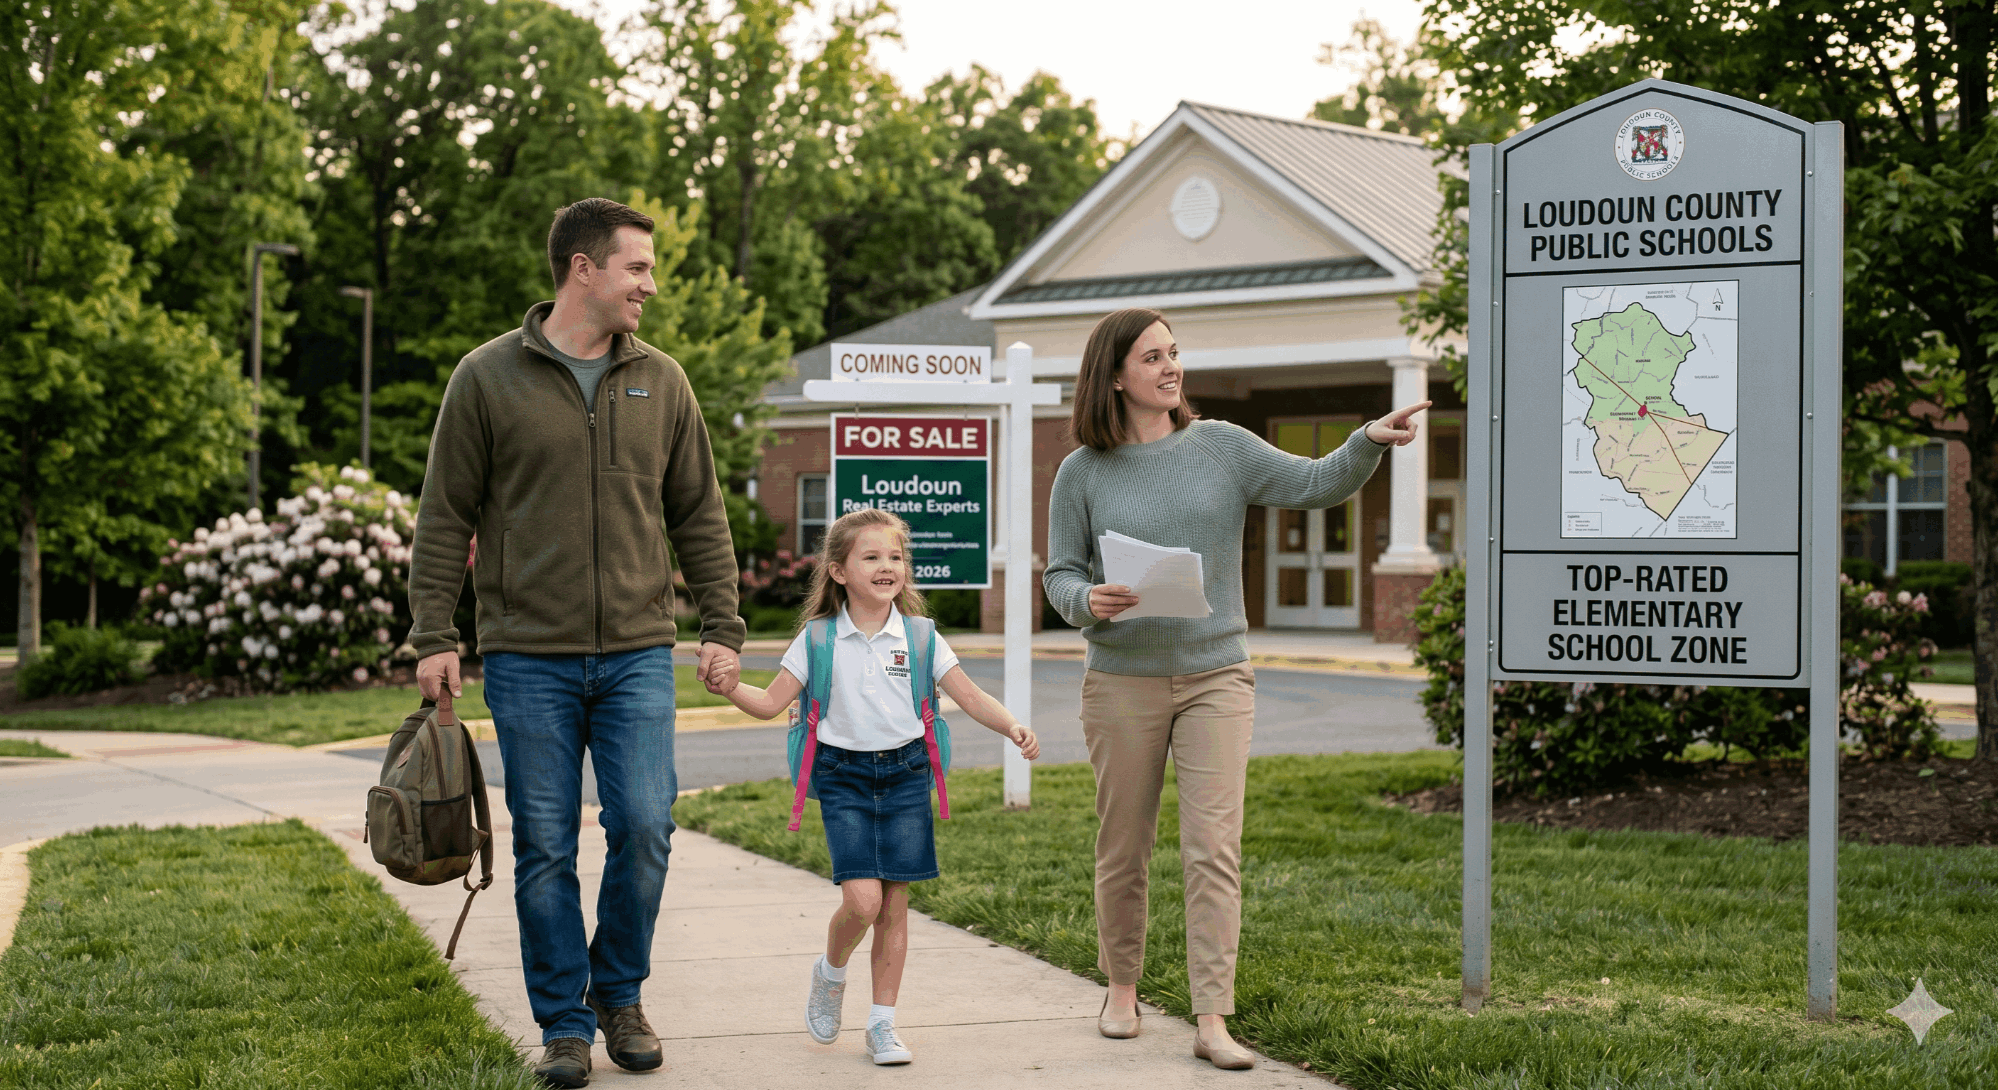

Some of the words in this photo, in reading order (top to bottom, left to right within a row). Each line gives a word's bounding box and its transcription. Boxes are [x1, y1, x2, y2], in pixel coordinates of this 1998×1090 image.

[1654, 111, 1681, 134] COUNTY
[1523, 195, 1655, 229] LOUDOUN
[1665, 189, 1783, 222] COUNTY
[1531, 231, 1630, 262] PUBLIC
[1639, 223, 1773, 256] SCHOOLS
[1715, 304, 1721, 312] N
[840, 353, 920, 374] COMING
[926, 354, 982, 375] SOON
[844, 425, 901, 449] FOR
[909, 426, 979, 450] SALE
[861, 474, 963, 496] Loudoun
[842, 498, 874, 512] Real
[877, 498, 923, 513] Estate
[926, 498, 981, 516] Experts
[914, 565, 951, 578] 2026
[1566, 564, 1728, 593] TOP-RATED
[1553, 599, 1744, 629] ELEMENTARY
[1547, 633, 1662, 663] SCHOOL
[1670, 635, 1748, 665] ZONE
